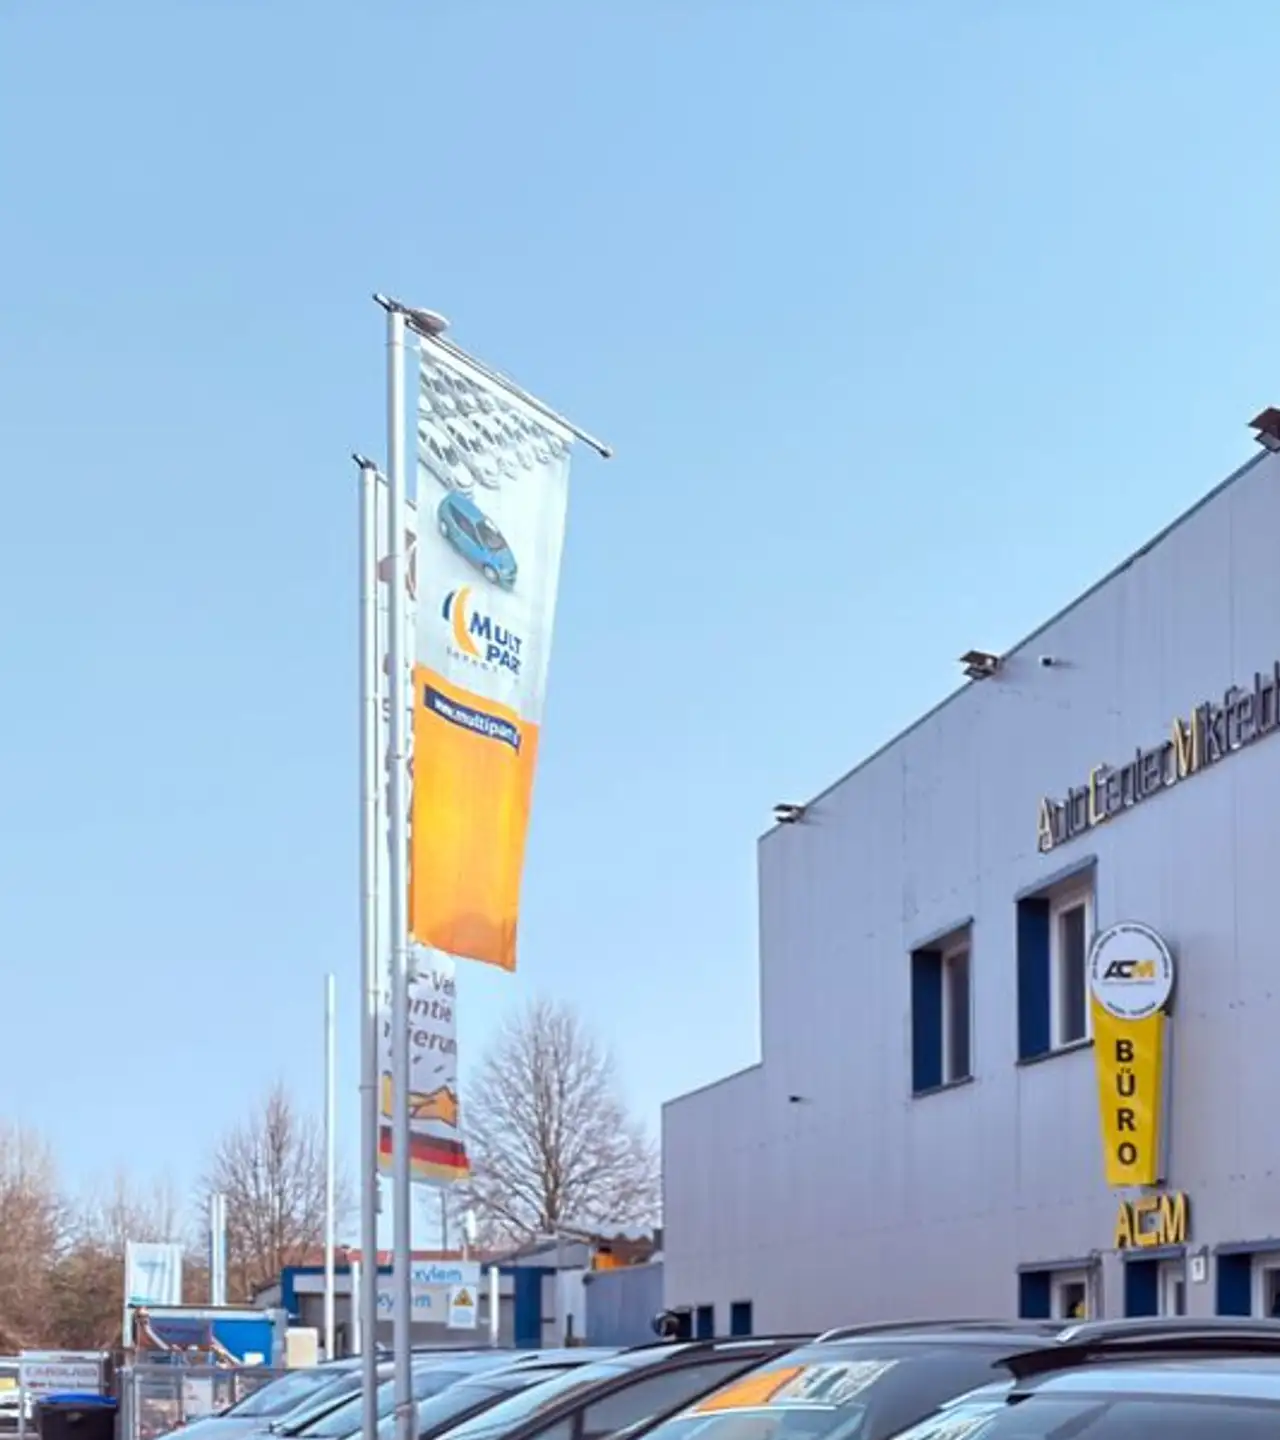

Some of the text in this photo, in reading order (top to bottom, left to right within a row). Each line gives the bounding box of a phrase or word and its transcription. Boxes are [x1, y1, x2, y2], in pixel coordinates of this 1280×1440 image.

[1103, 959, 1156, 980] ACM
[1115, 1039, 1138, 1166] BÜRO
[1113, 1191, 1190, 1248] ACM
